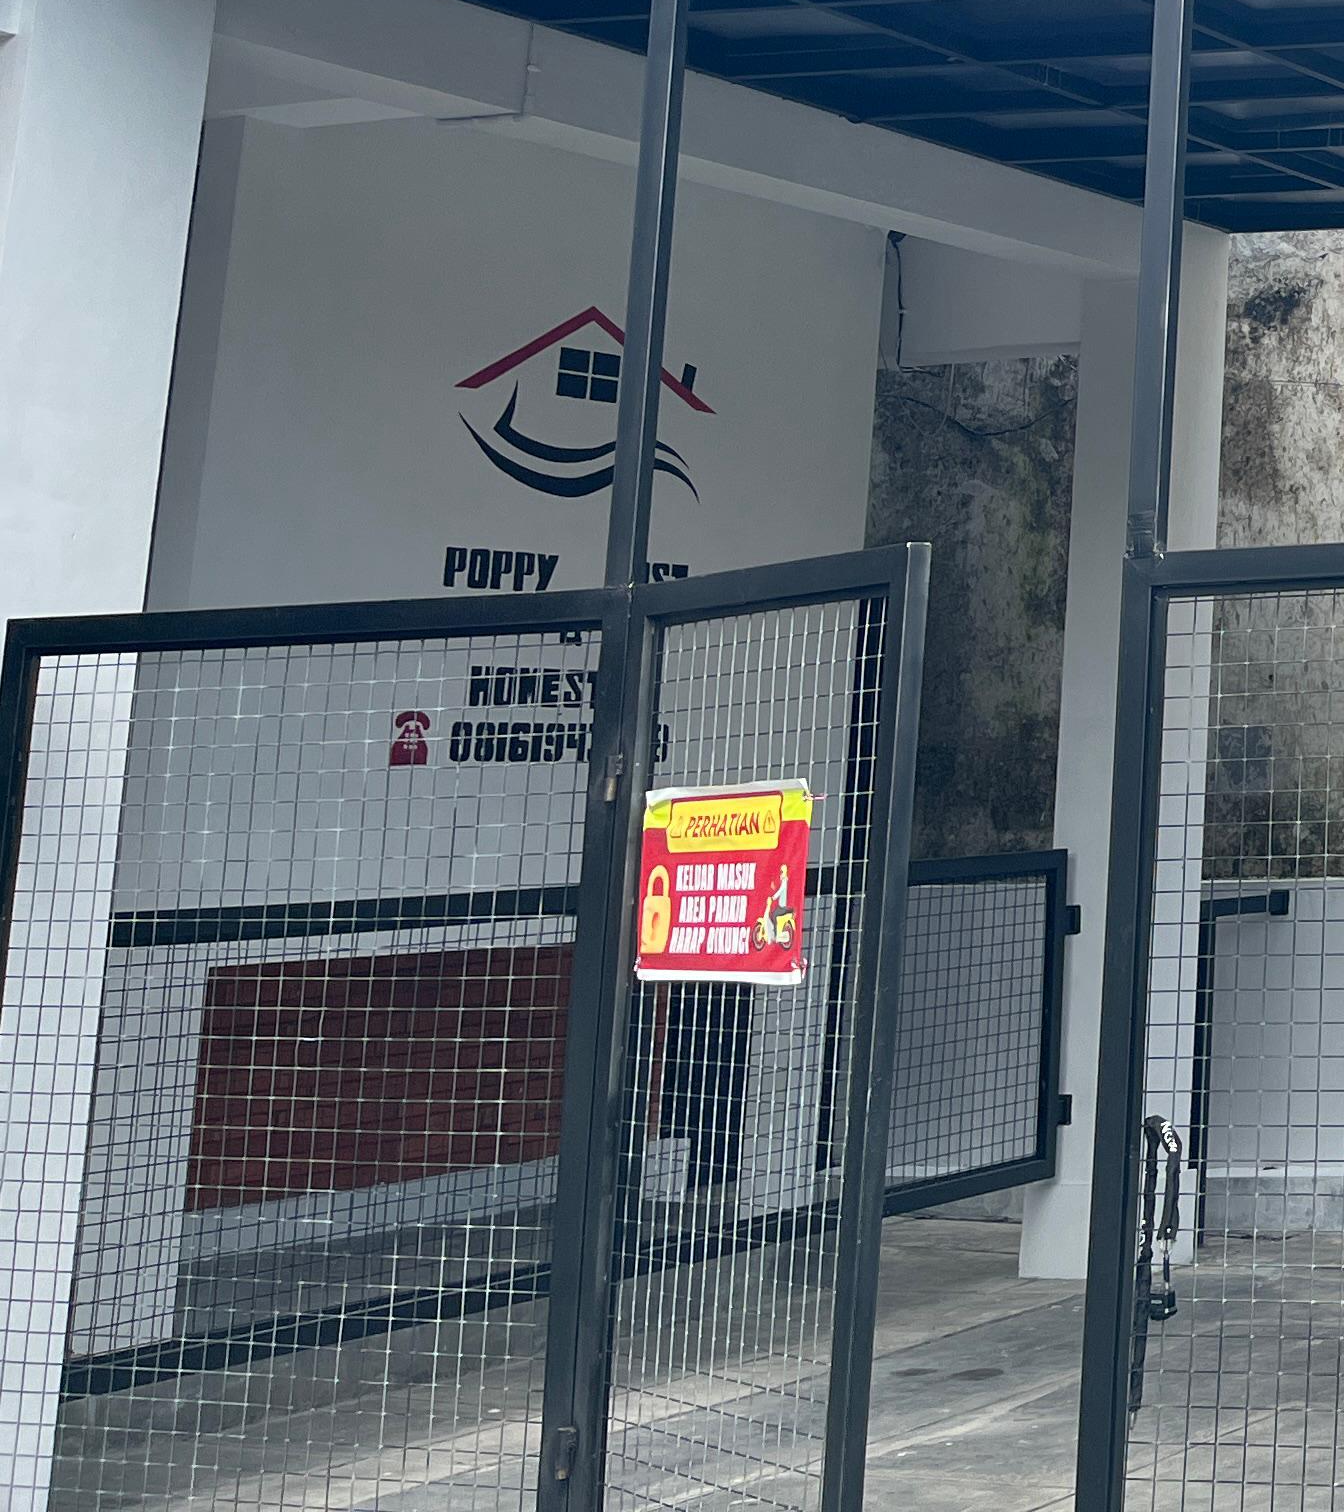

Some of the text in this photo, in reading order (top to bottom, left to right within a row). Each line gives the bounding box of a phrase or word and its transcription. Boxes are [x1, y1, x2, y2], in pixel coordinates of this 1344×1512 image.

[443, 546, 560, 592] POPPY
[685, 811, 760, 838] PERHATIAN
[676, 862, 756, 891] KELUAR MASUK
[678, 895, 747, 923] AREA PARKIR
[669, 926, 751, 954] HARAP DIKUNCI
